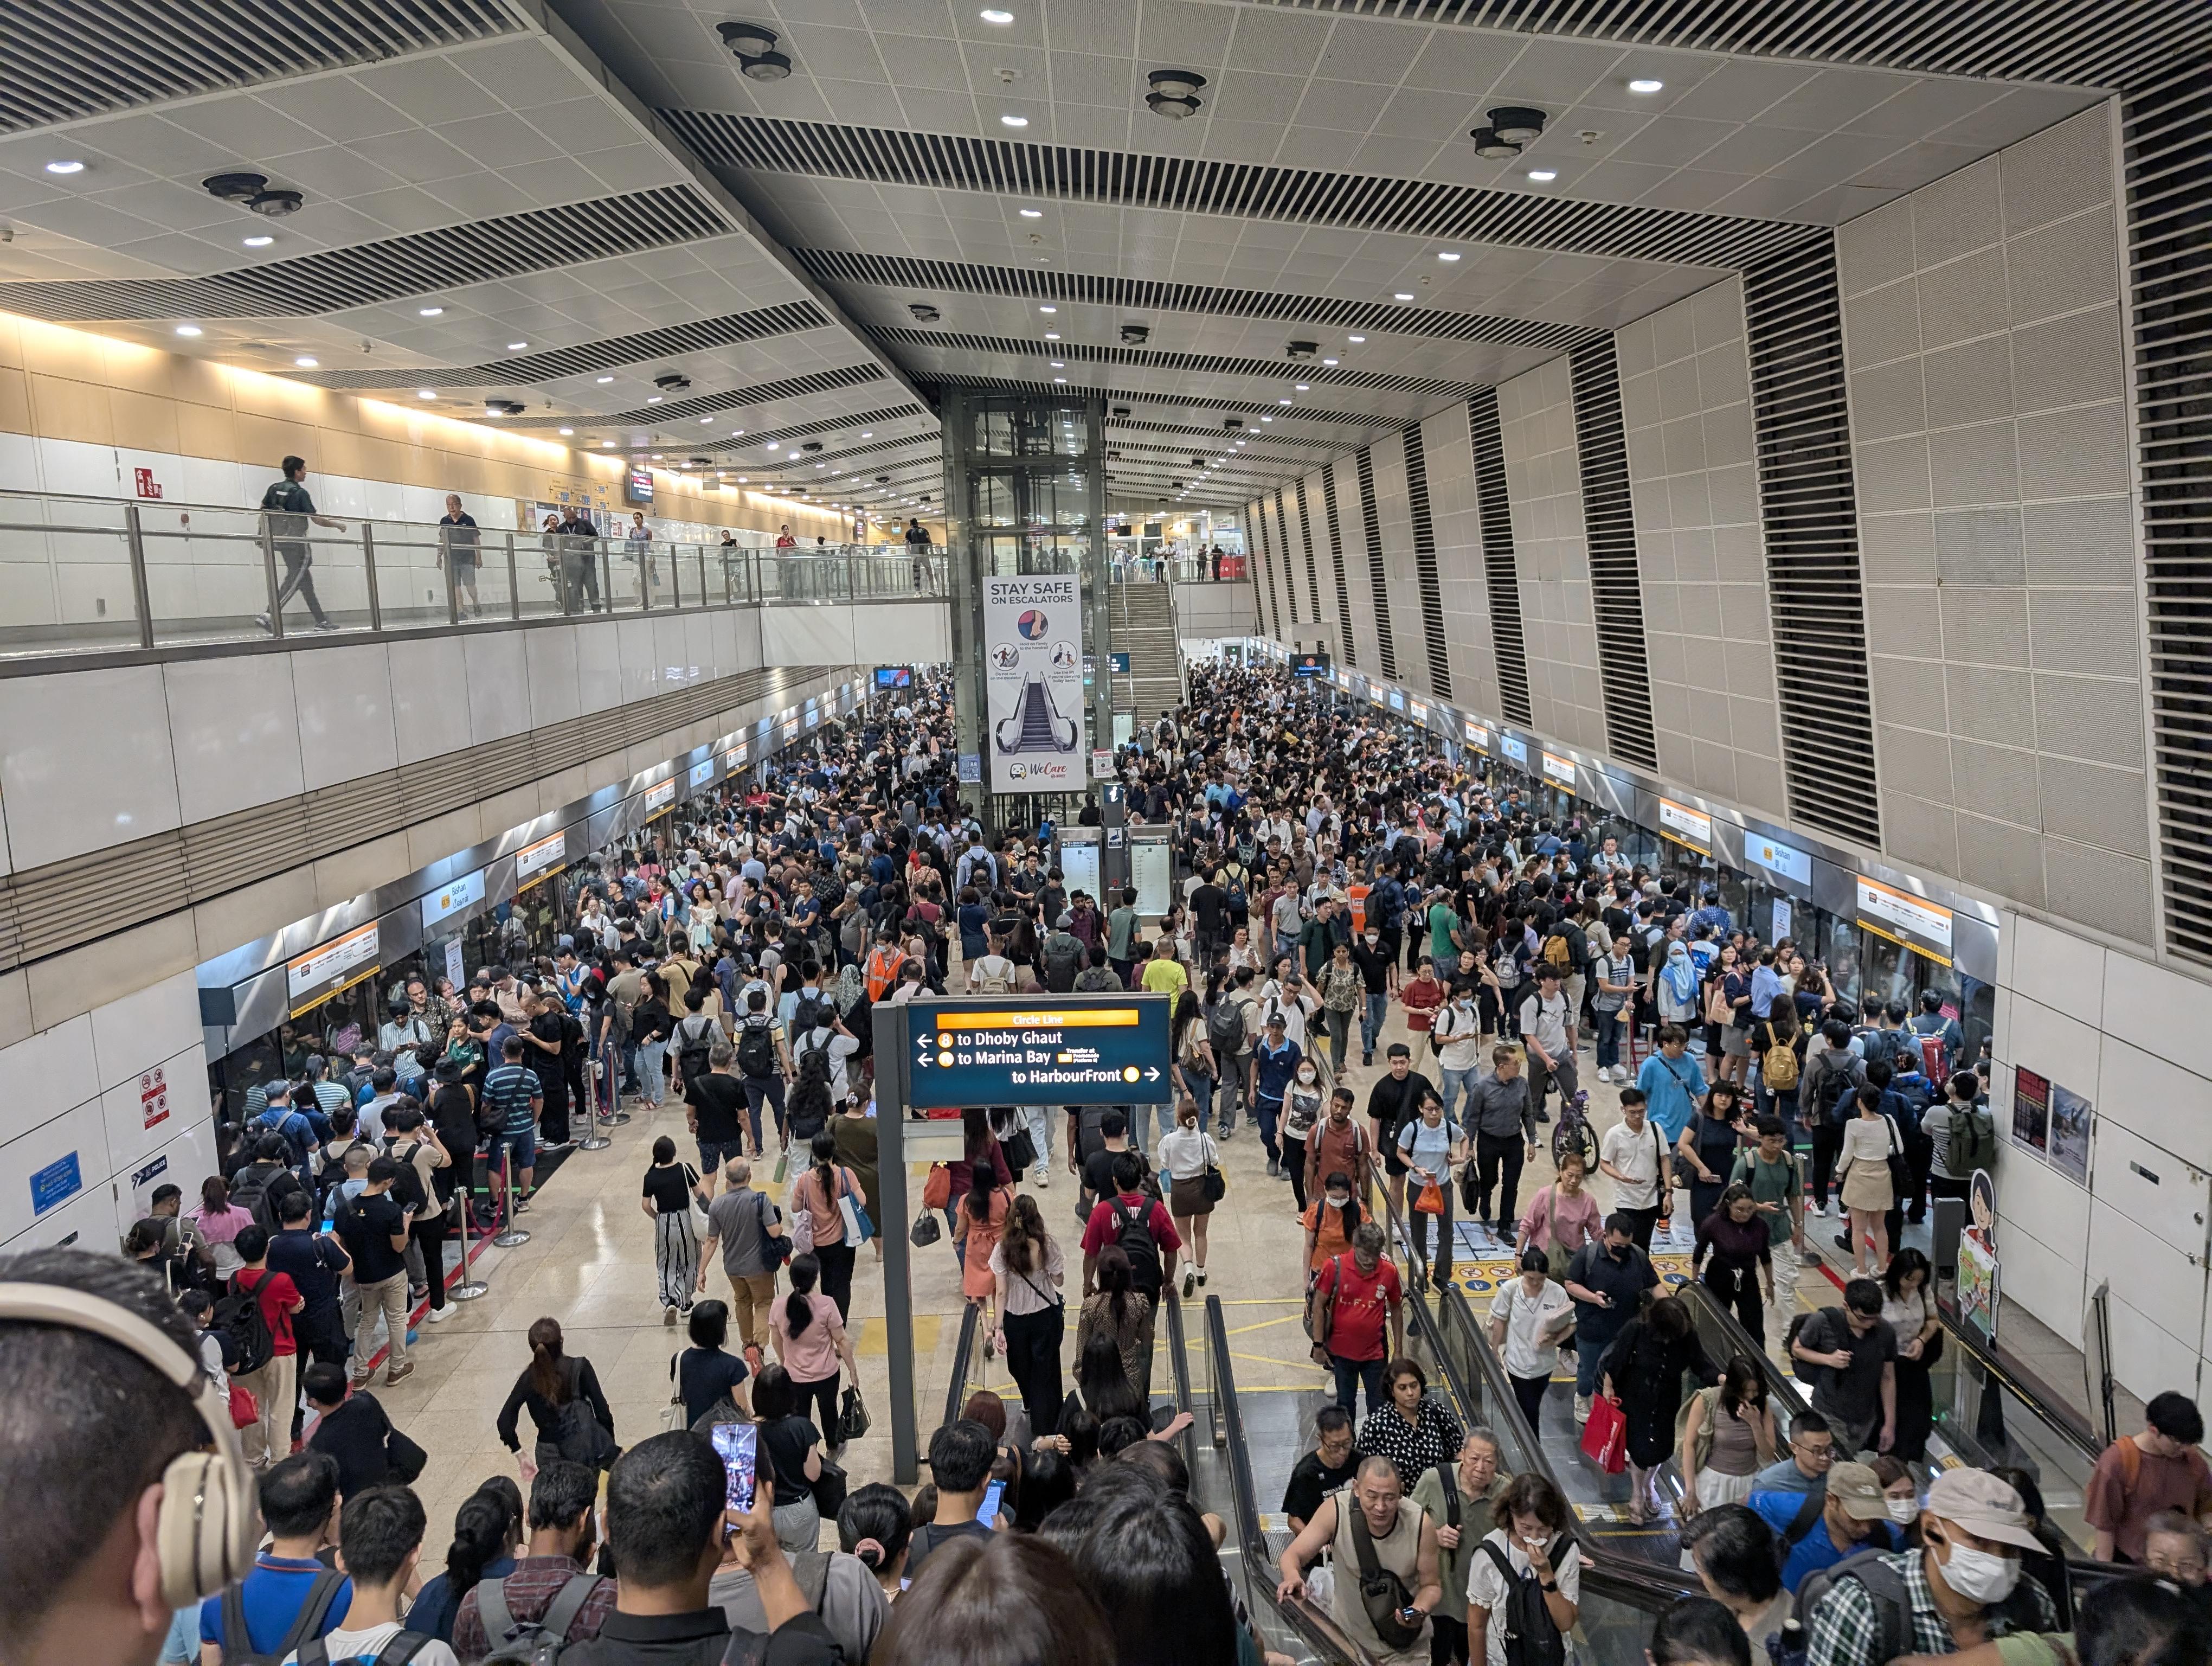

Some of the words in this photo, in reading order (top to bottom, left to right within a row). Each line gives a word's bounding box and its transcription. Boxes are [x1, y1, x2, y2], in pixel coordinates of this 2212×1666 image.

[991, 583, 1029, 595] STAY
[1033, 582, 1073, 594] SAFE
[991, 597, 1007, 605] ON
[1009, 595, 1073, 604] ESCALATORS
[1030, 762, 1067, 775] WeCare
[1775, 846, 1790, 861] Bishan
[452, 883, 466, 896] Bishan
[1013, 1015, 1040, 1025] Circle
[1043, 1014, 1063, 1024] Line
[942, 1035, 950, 1046] 8
[957, 1034, 971, 1046] to
[976, 1031, 1018, 1047] Dhoby
[1022, 1031, 1062, 1044] Ghaut
[958, 1053, 972, 1065] to
[976, 1050, 1023, 1064] Marina
[1027, 1050, 1050, 1065] Bay
[1012, 1071, 1026, 1083] to
[1030, 1069, 1121, 1083] HarbourFront
[152, 1159, 165, 1171] POLICE
